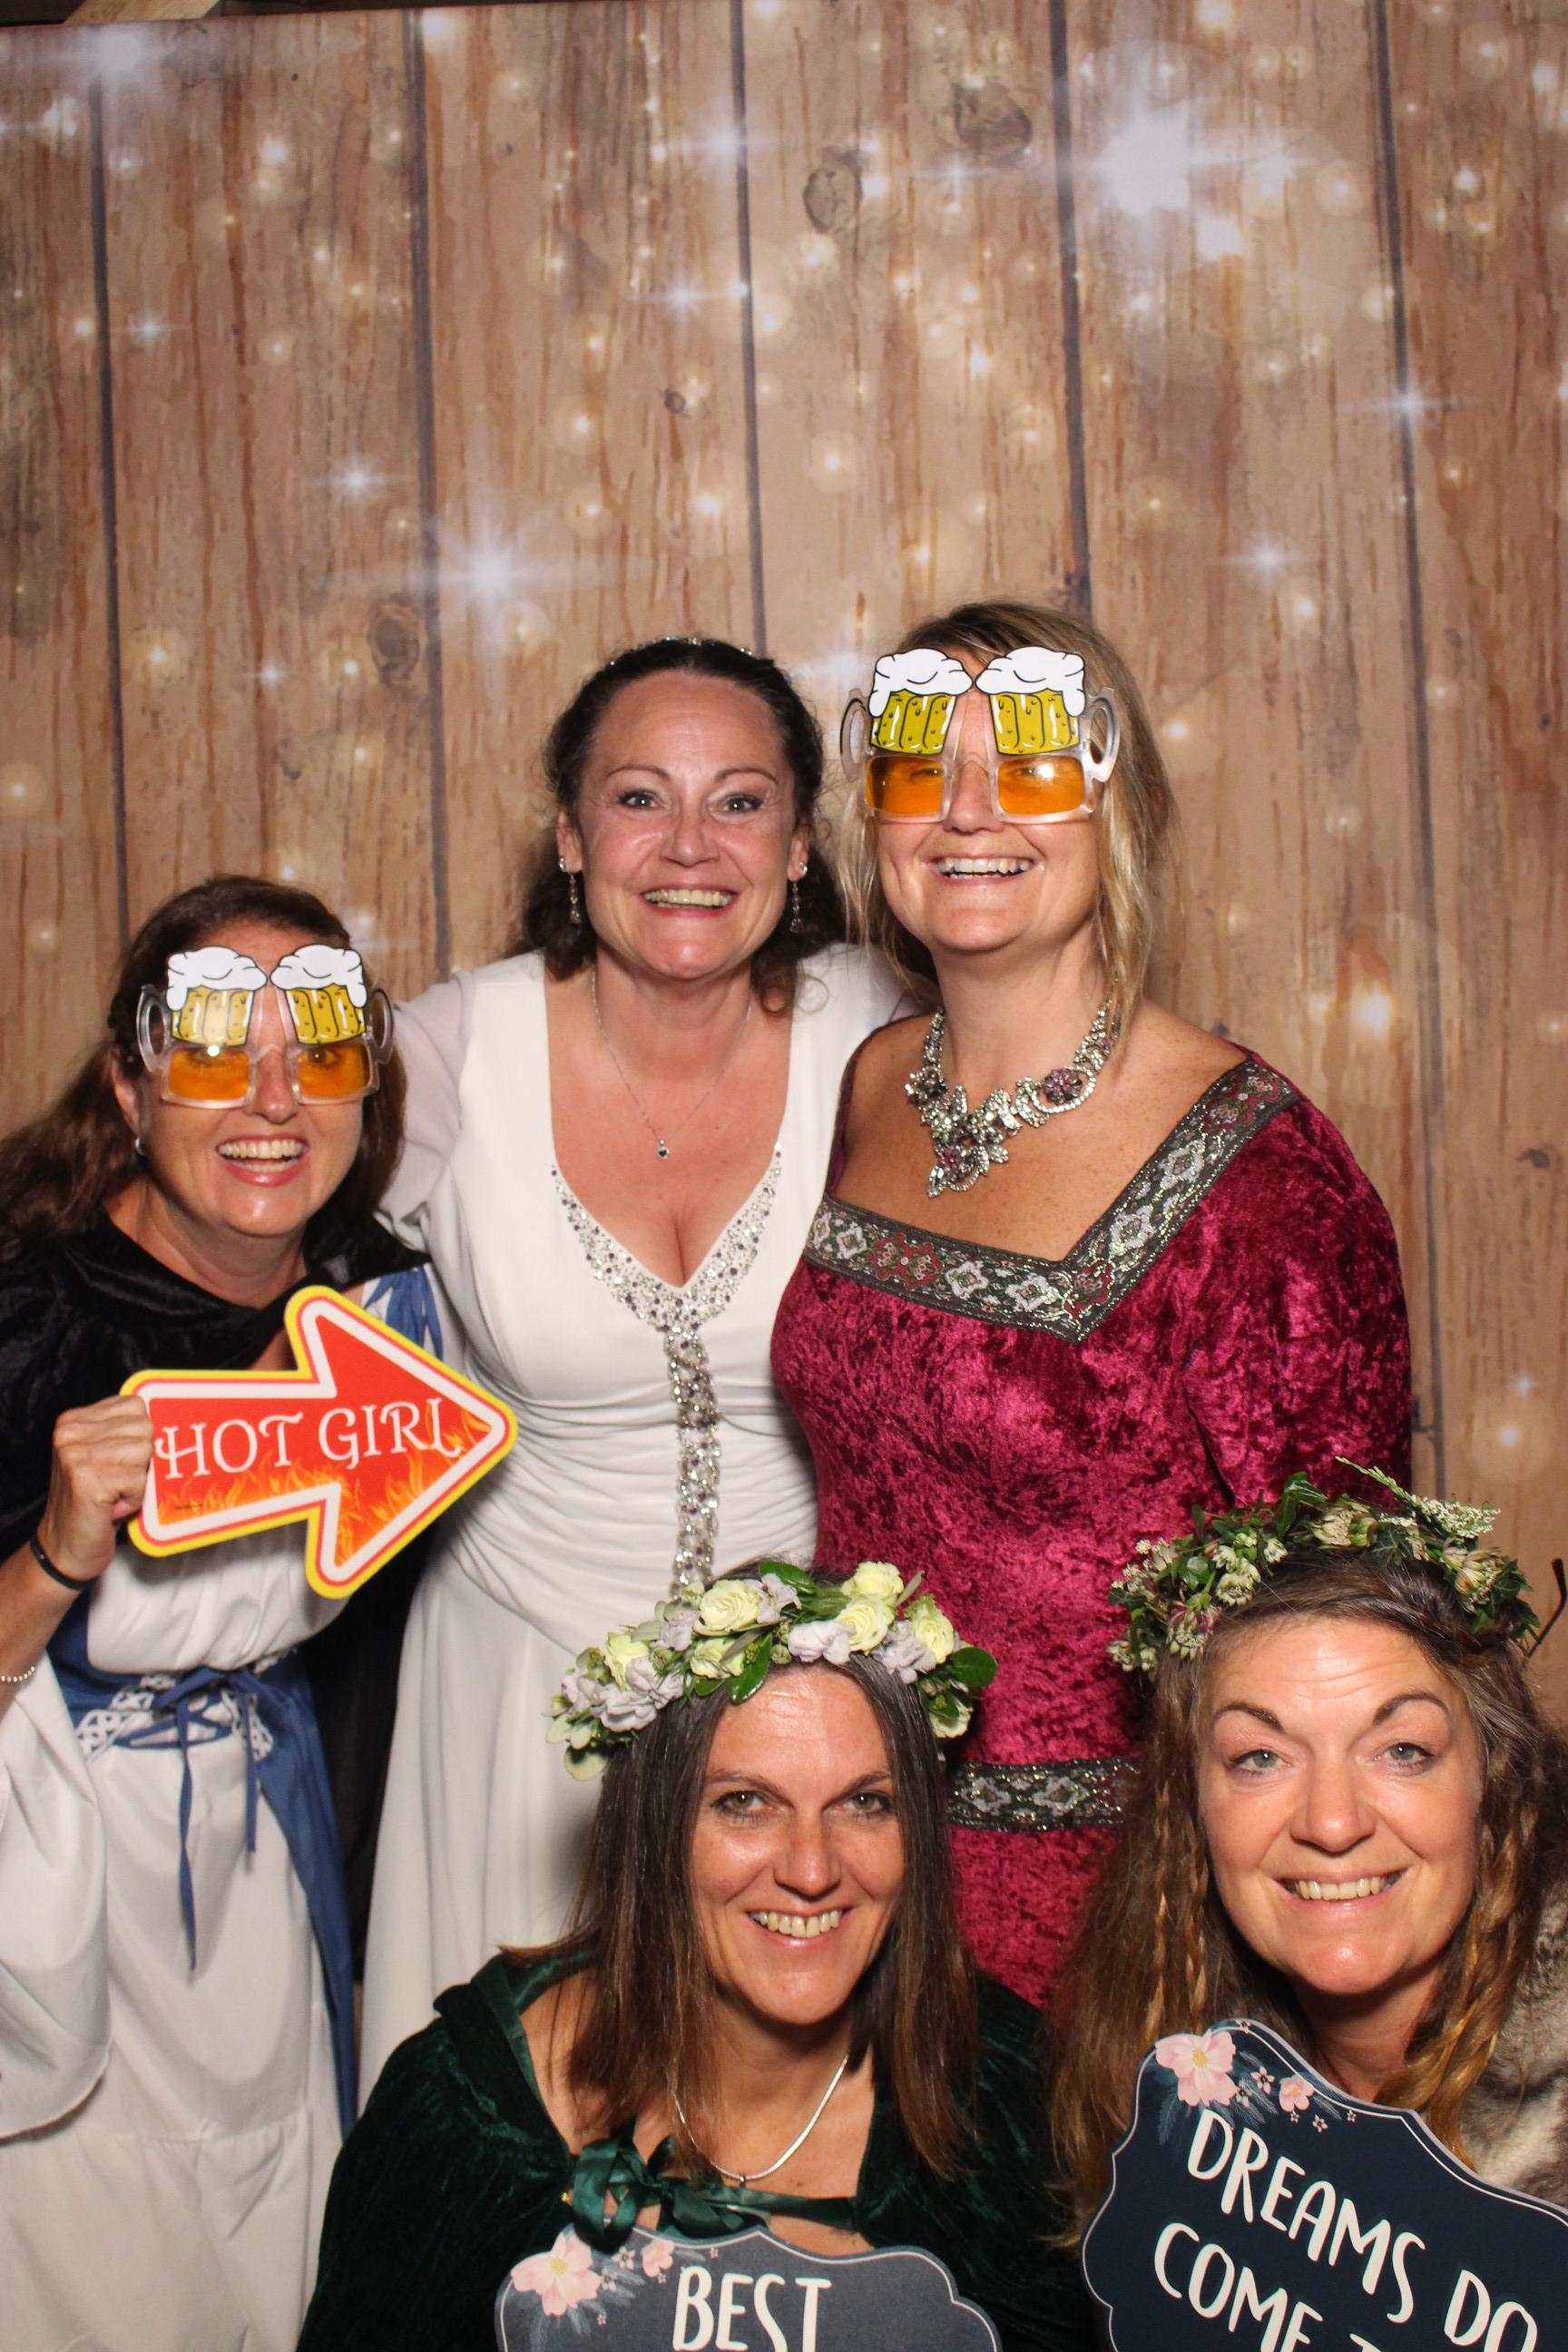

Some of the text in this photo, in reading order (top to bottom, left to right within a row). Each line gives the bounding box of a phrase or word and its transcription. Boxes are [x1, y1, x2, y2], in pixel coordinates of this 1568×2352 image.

[154, 1397, 461, 1480] HOT GIRL
[1188, 2110, 1538, 2352] DREAMS DO
[672, 2266, 832, 2352] BEST
[1154, 2222, 1324, 2352] COME
